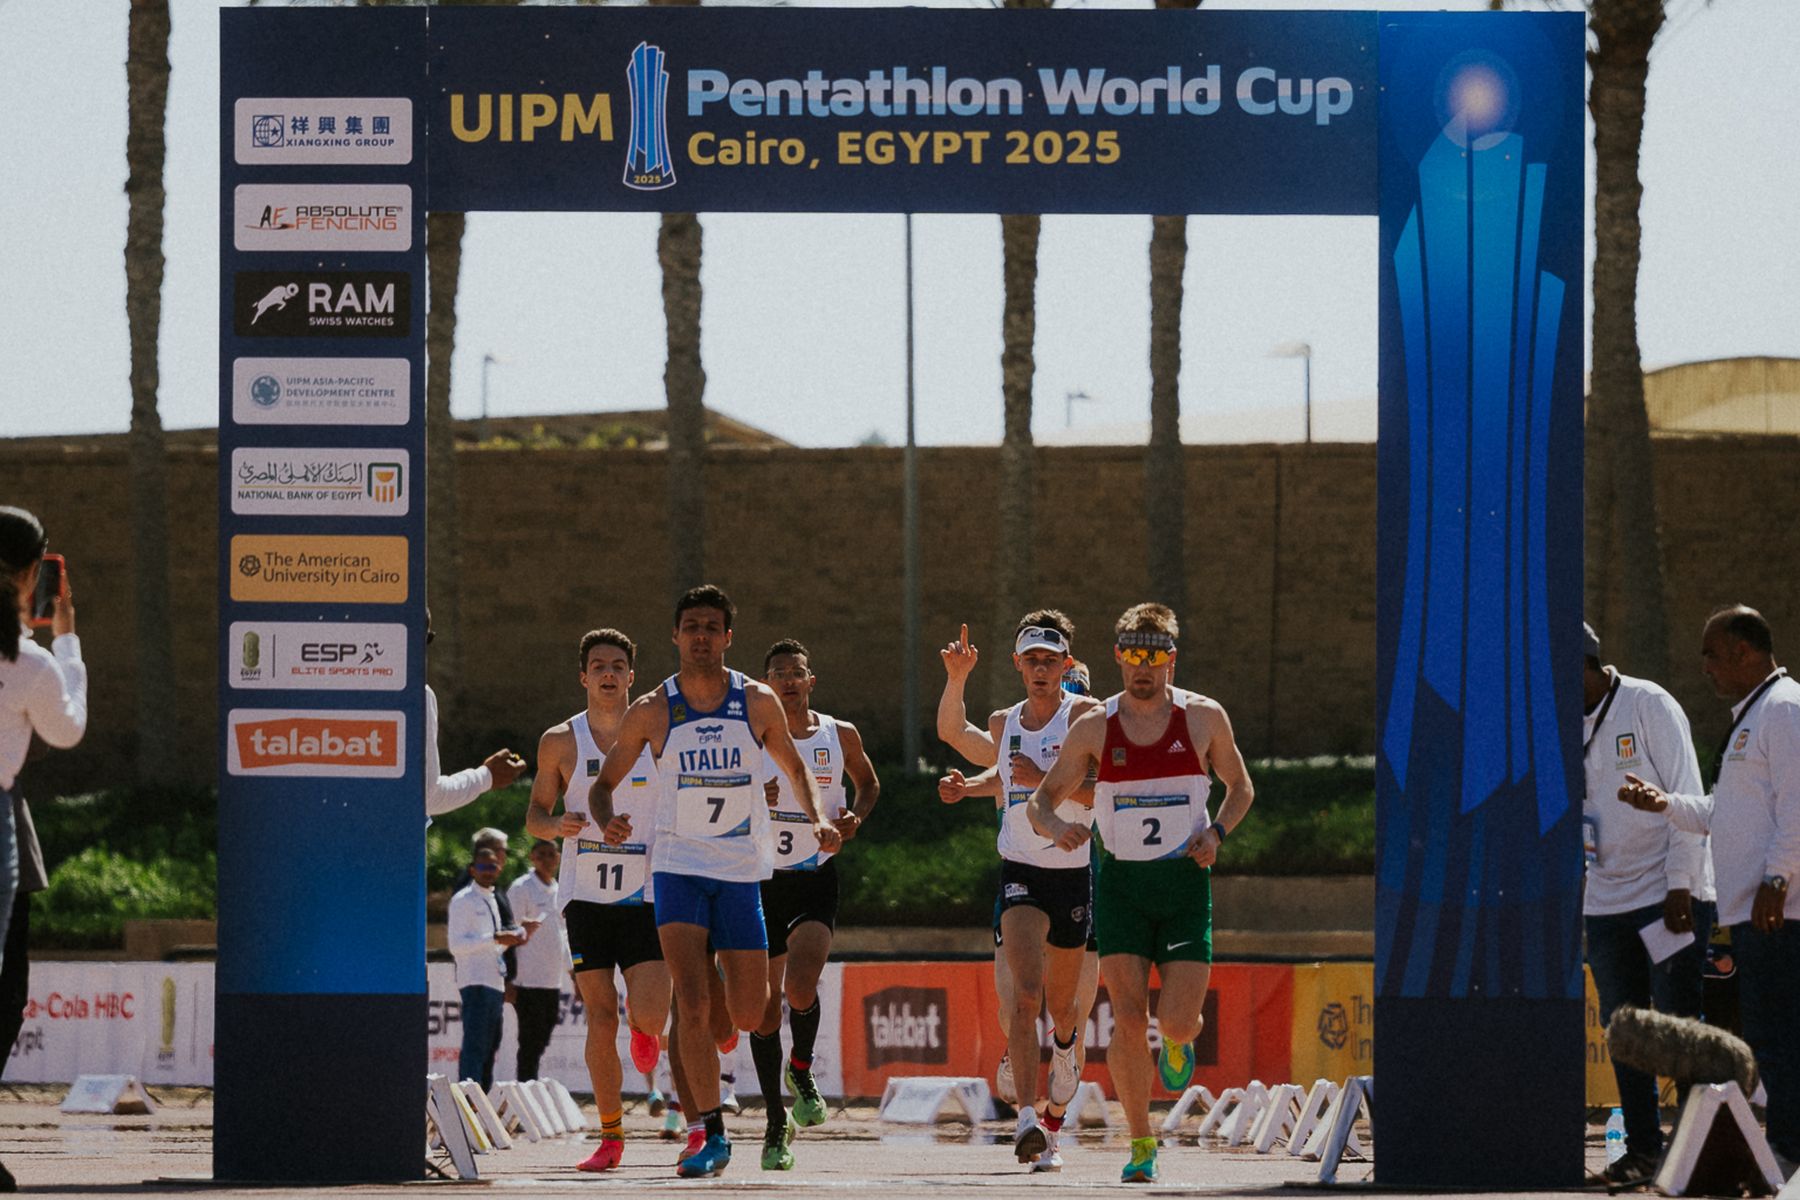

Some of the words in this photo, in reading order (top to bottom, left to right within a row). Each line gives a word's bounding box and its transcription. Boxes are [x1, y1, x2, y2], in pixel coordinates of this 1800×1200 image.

[687, 66, 1023, 117] Pentathlon
[1038, 65, 1221, 116] World
[1236, 67, 1353, 126] Cup
[291, 115, 391, 135] 祥興集團
[450, 92, 614, 143] UIPM
[286, 138, 351, 147] XIANGXING
[355, 138, 395, 147] GROUP
[687, 131, 820, 169] Cairo,
[838, 131, 990, 165] EGYPT
[1005, 131, 1121, 165] 2025
[633, 175, 661, 184] 2025
[295, 217, 397, 231] FENCING
[308, 283, 395, 313] RAM
[309, 317, 342, 326] SWISS
[345, 317, 394, 326] WATCHES
[286, 377, 311, 385] UIPM
[313, 377, 375, 386] ASIA-PACIFIC
[286, 389, 355, 397] DEVELOPMENT
[358, 389, 395, 397] CENTRE
[238, 490, 284, 500] NATIONAL
[287, 490, 313, 500] BANK
[316, 491, 329, 500] OF
[332, 491, 363, 501] EGYPT
[265, 552, 293, 567] The
[297, 552, 371, 567] American
[263, 568, 340, 586] University
[343, 569, 357, 583] in
[360, 569, 400, 584] Cairo
[301, 643, 357, 662] ESP
[291, 666, 322, 675] ELITE
[328, 667, 369, 676] SPORTS
[372, 667, 393, 676] PRO
[250, 728, 383, 757] talabat
[679, 747, 741, 773] ITALIA
[707, 797, 725, 823] 7
[1142, 818, 1162, 845] 2
[580, 841, 600, 852] UIPM
[777, 831, 794, 855] 3
[596, 863, 623, 891] 11
[95, 991, 135, 1020] HBC
[870, 1002, 941, 1048] talabat
